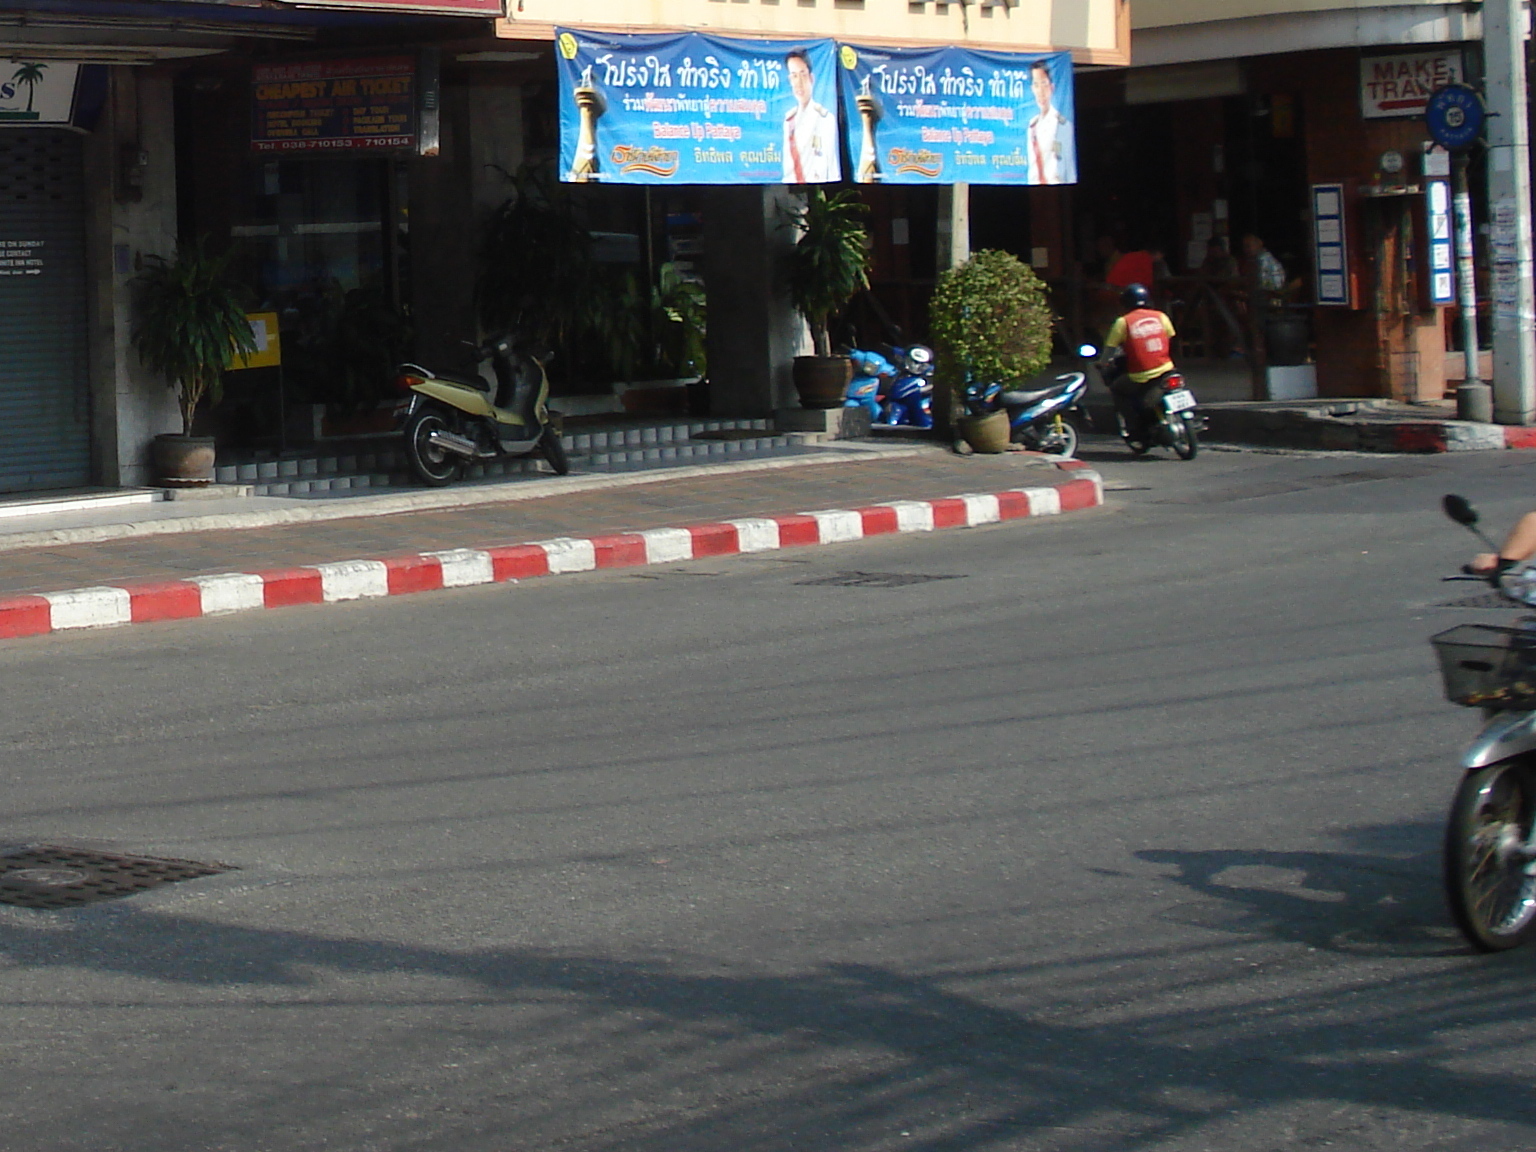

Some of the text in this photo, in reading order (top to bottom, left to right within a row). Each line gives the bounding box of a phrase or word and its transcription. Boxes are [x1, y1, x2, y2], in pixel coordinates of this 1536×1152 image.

[1374, 57, 1448, 81] MAKE
[281, 139, 353, 150] 038-710153
[365, 136, 410, 147] 710154
